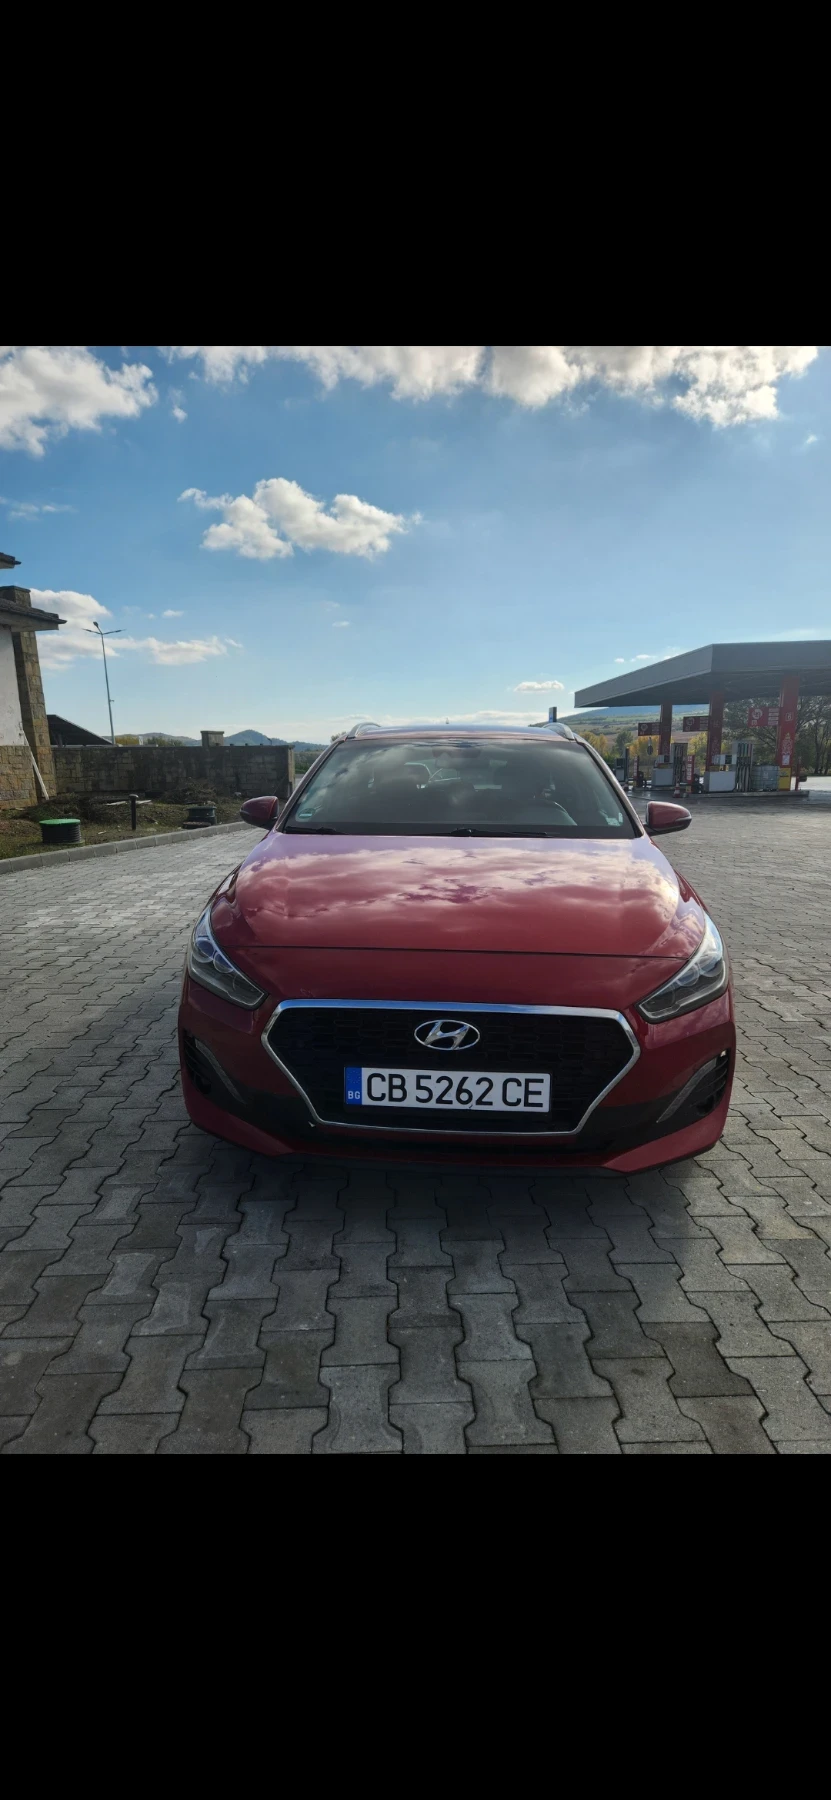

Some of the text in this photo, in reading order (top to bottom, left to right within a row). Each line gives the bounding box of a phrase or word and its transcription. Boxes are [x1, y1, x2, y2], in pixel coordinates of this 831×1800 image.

[347, 1090, 361, 1100] BG
[366, 1073, 544, 1107] CB 5262 CE
